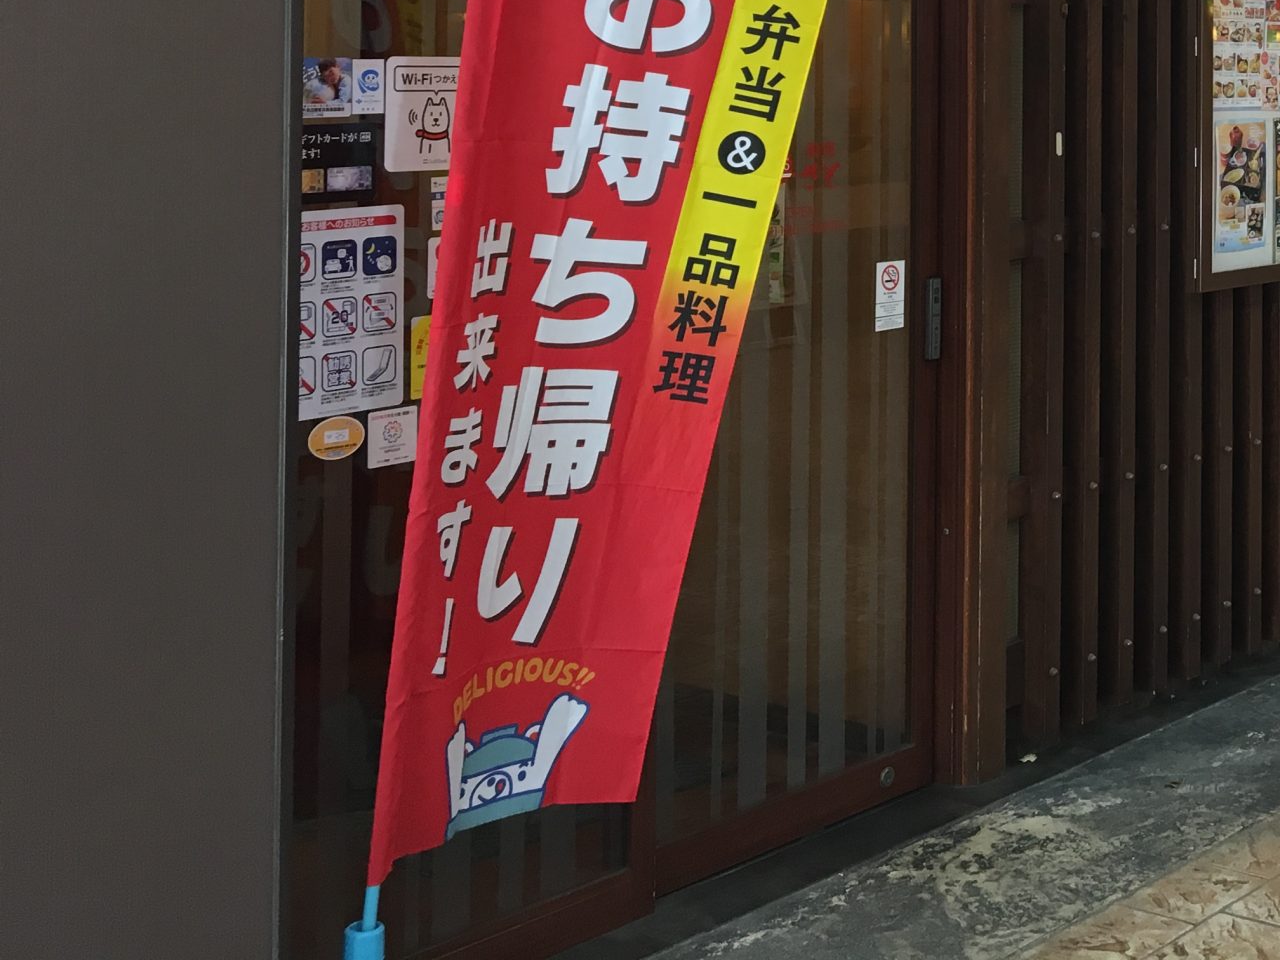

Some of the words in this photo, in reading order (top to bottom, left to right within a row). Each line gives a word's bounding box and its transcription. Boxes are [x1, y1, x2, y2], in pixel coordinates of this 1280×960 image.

[430, 217, 514, 676] 出来ます!
[452, 656, 596, 722] DELICIOUS!!
